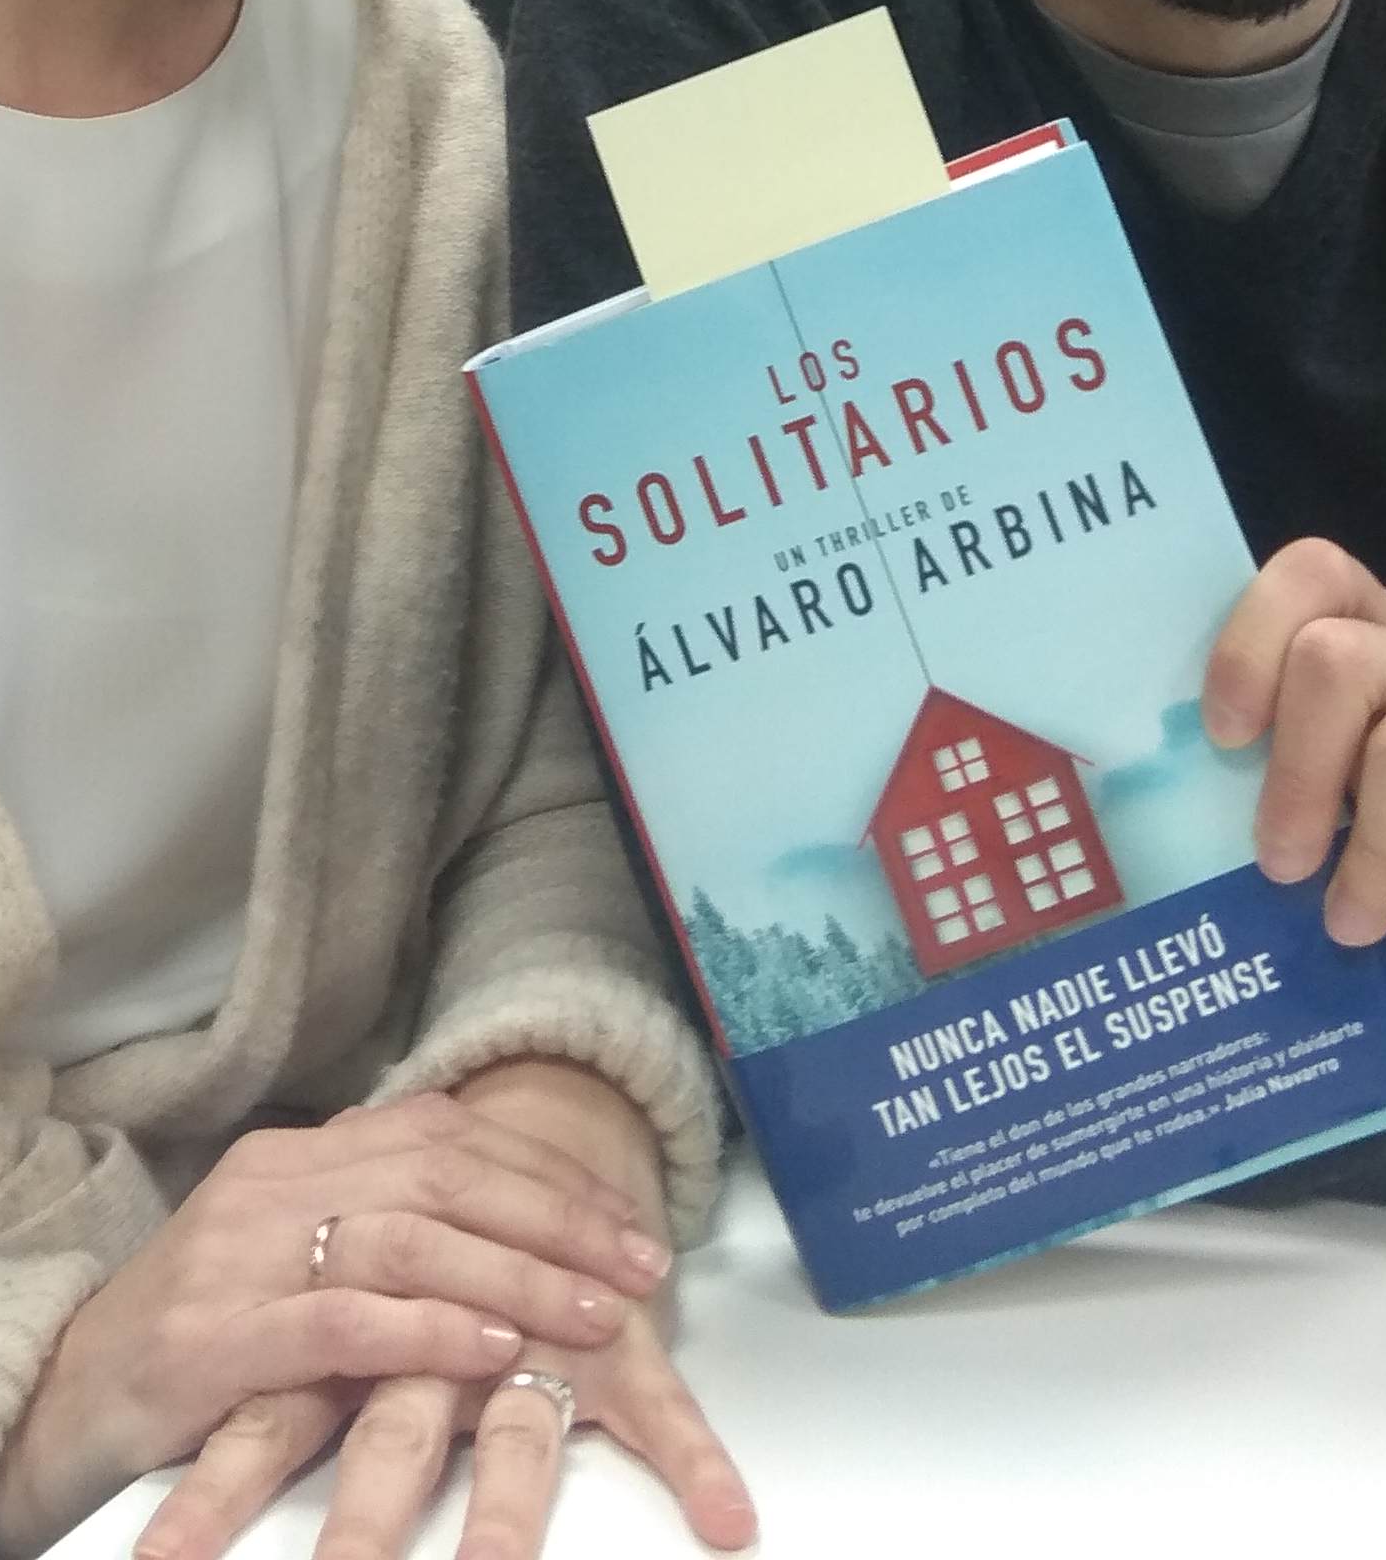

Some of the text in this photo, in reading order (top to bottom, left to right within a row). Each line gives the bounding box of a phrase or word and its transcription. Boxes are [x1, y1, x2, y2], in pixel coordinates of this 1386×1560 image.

[579, 318, 1107, 567] SOLITARIOS
[767, 338, 860, 406] LOS
[635, 460, 1157, 692] ÁLVARO ARBINA
[773, 484, 972, 573] UN THRILLER DE
[871, 952, 1282, 1138] TAN LEJOS EL SUSPENSE
[889, 913, 1226, 1081] NUNCA NADIE LLEVÓ
[853, 1207, 873, 1223] te
[874, 1180, 949, 1216] devuelve
[949, 1170, 970, 1190] el
[969, 1151, 1023, 1186] placer
[1025, 1142, 1050, 1161] de
[1050, 1105, 1146, 1152] sumergirte
[1147, 1095, 1171, 1114] en
[1171, 1082, 1206, 1104] una
[1205, 1056, 1274, 1090] historia
[1287, 1021, 1364, 1059] olvidarte
[895, 1214, 925, 1238] por
[927, 1186, 1007, 1224] completo
[1007, 1171, 1039, 1194] del
[1037, 1150, 1099, 1183] mundo
[1099, 1137, 1133, 1160] que
[1133, 1129, 1154, 1145] te
[1224, 1085, 1268, 1112] Julia
[1265, 1057, 1340, 1094] Navarro
[988, 1128, 1008, 1149] el
[1007, 1119, 1043, 1141] don
[1042, 1110, 1066, 1128] de
[1065, 1098, 1096, 1118] los
[1095, 1070, 1168, 1110] grandes
